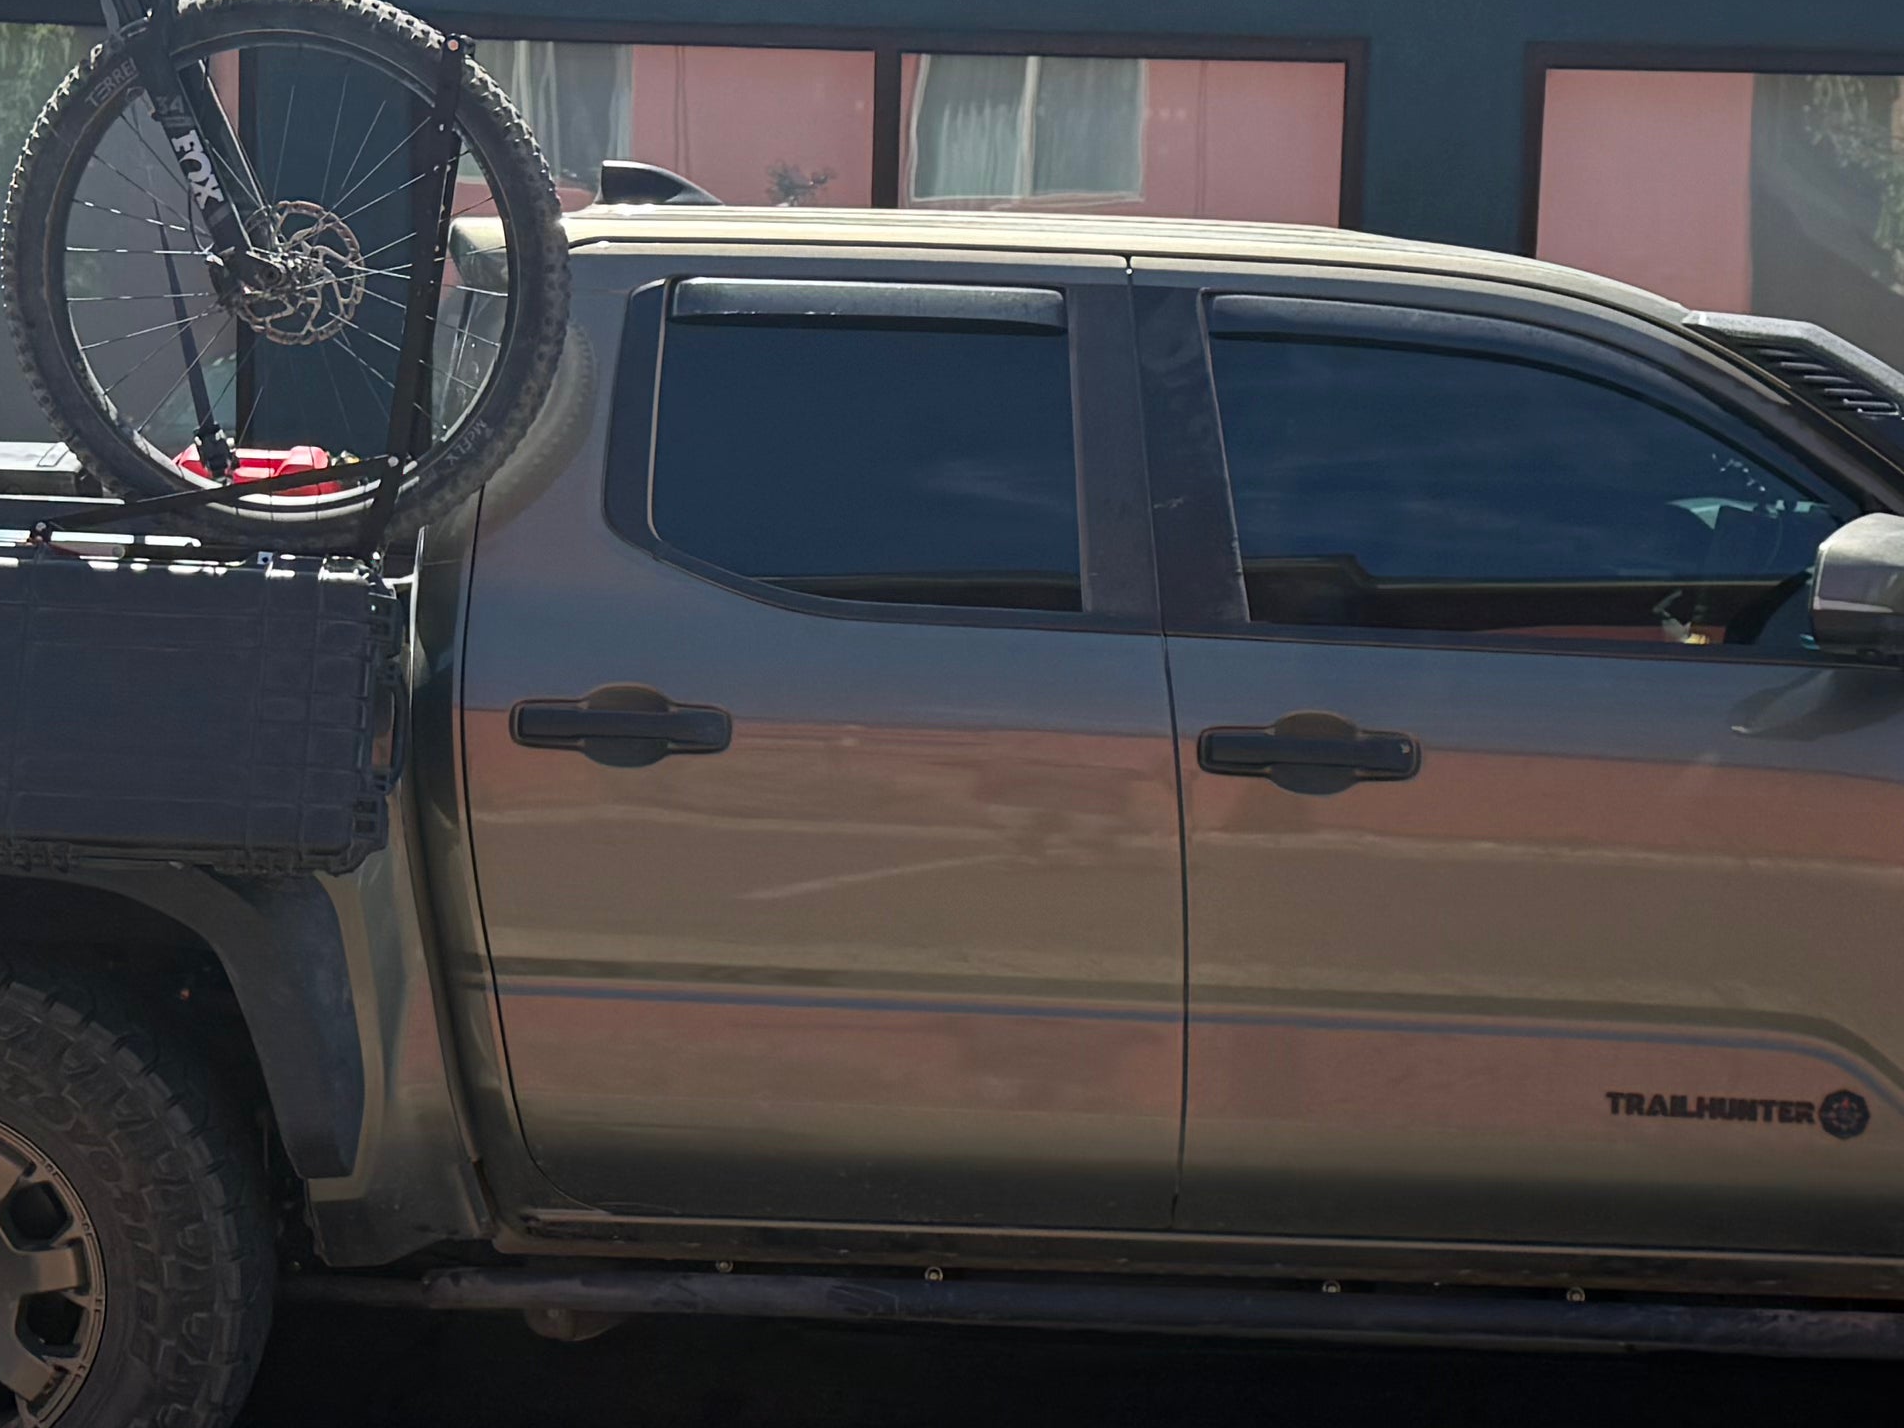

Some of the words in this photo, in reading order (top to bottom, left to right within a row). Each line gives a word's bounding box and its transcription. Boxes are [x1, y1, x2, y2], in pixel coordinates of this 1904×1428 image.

[84, 56, 139, 108] TERRE
[171, 128, 225, 211] FOX
[1605, 1091, 1816, 1125] TRAILHUNTER
